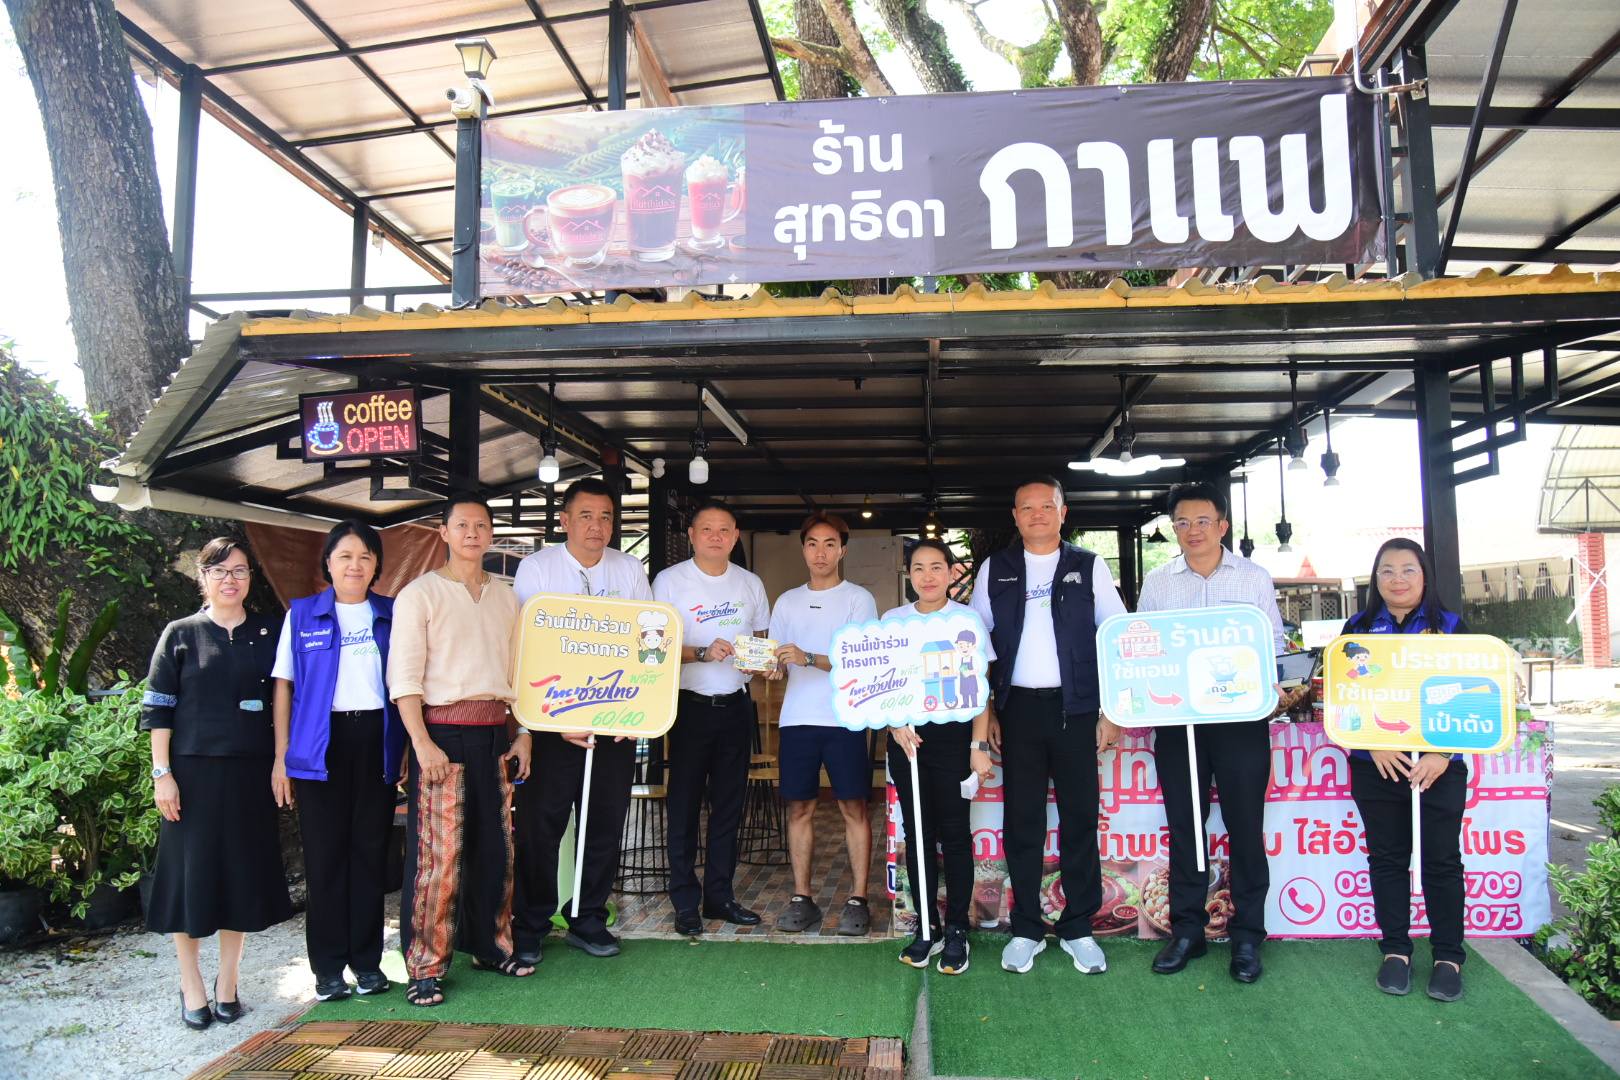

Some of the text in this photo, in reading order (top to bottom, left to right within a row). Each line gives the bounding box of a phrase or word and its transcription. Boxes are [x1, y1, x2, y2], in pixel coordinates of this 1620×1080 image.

[812, 120, 903, 175] ร้าน
[979, 93, 1354, 250] กาแฟ
[773, 190, 946, 260] สุทธิดา
[344, 394, 412, 424] coffee
[347, 424, 409, 453] OPEN
[534, 607, 631, 634] ร้านนี้เข้าร่วม
[718, 617, 742, 627] 60/40
[1170, 618, 1255, 648] ร้านค้า
[560, 636, 629, 657] โครงการ
[841, 635, 909, 655] ร้านนี้เข้าร่วม
[841, 655, 890, 669] โครงการ
[1391, 646, 1500, 671] ประชาชน
[880, 694, 914, 711] 60/40
[591, 707, 645, 729] 60/40
[1428, 711, 1494, 734] เป๋าตัง
